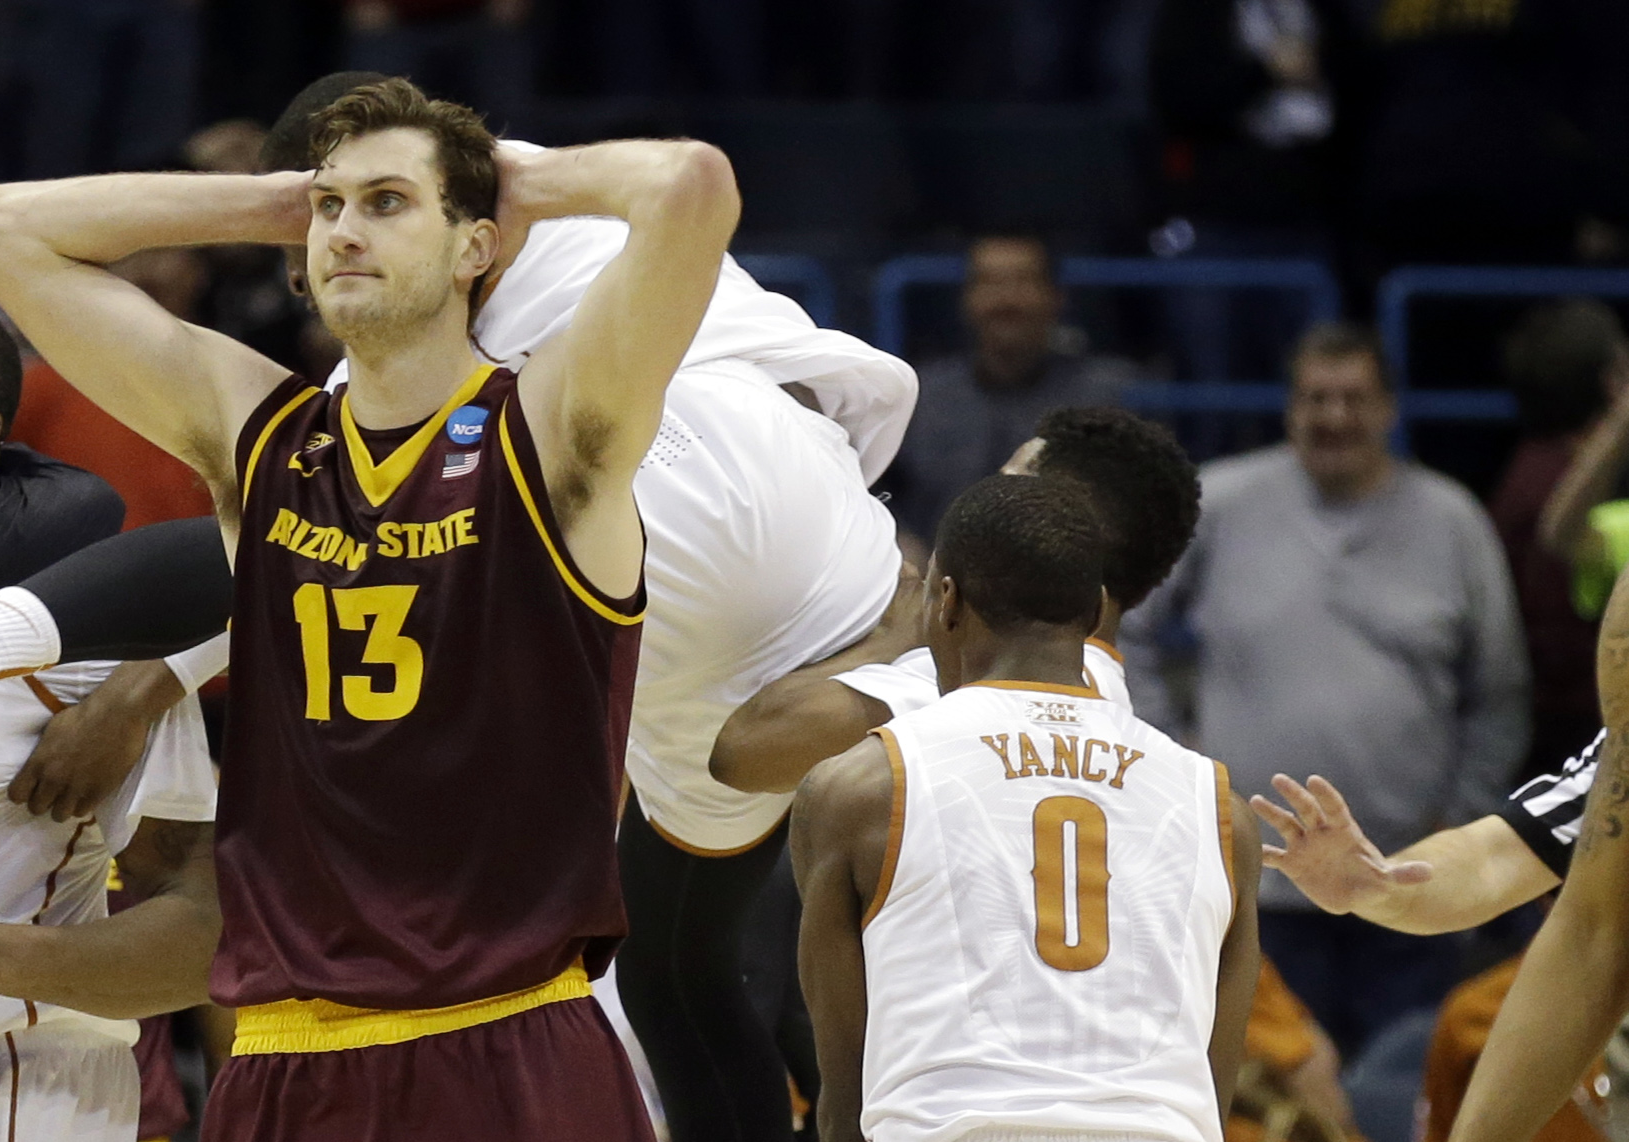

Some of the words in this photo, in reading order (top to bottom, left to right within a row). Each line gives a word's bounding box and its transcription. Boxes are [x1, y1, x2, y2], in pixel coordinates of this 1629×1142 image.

[265, 507, 369, 571] ARIZON
[376, 507, 480, 559] STATE
[292, 582, 424, 722] 13
[980, 731, 1145, 789] YANCY
[1029, 795, 1112, 972] 0
